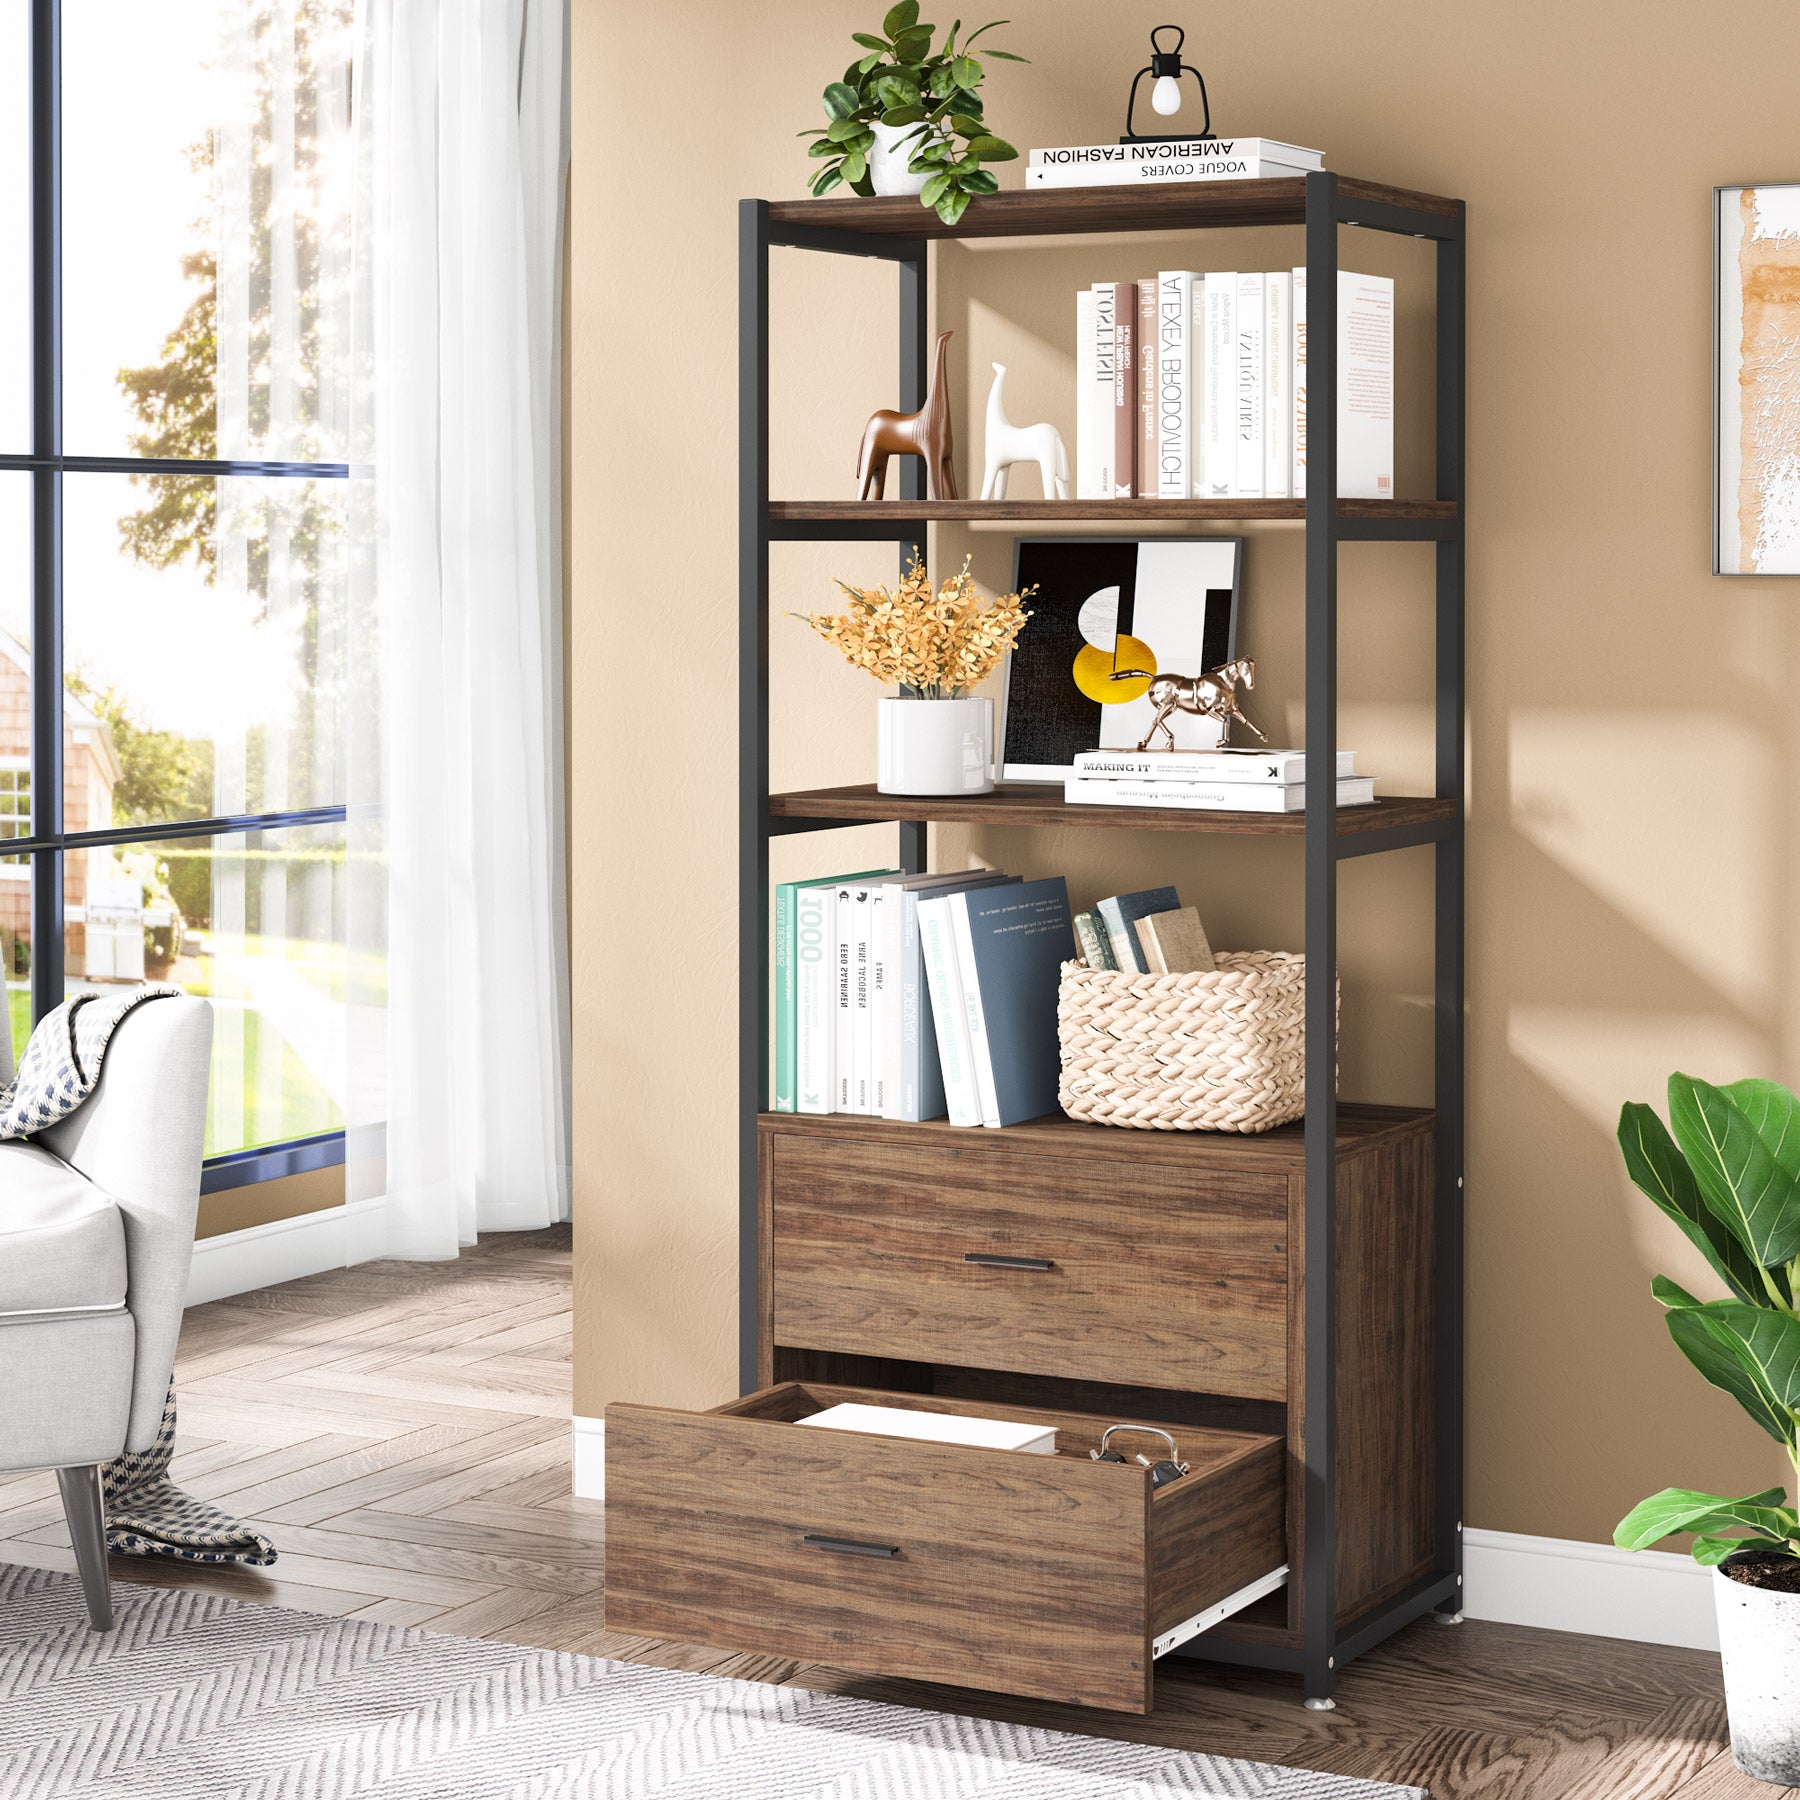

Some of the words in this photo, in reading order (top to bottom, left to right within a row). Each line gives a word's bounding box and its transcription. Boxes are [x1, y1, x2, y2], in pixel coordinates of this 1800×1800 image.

[1043, 147, 1125, 165] FASHION
[1132, 142, 1234, 159] AMERICAN
[1141, 164, 1194, 177] COVERS
[1199, 161, 1247, 174] VOGUE
[1083, 762, 1134, 772] MAKING
[1138, 764, 1151, 772] IT
